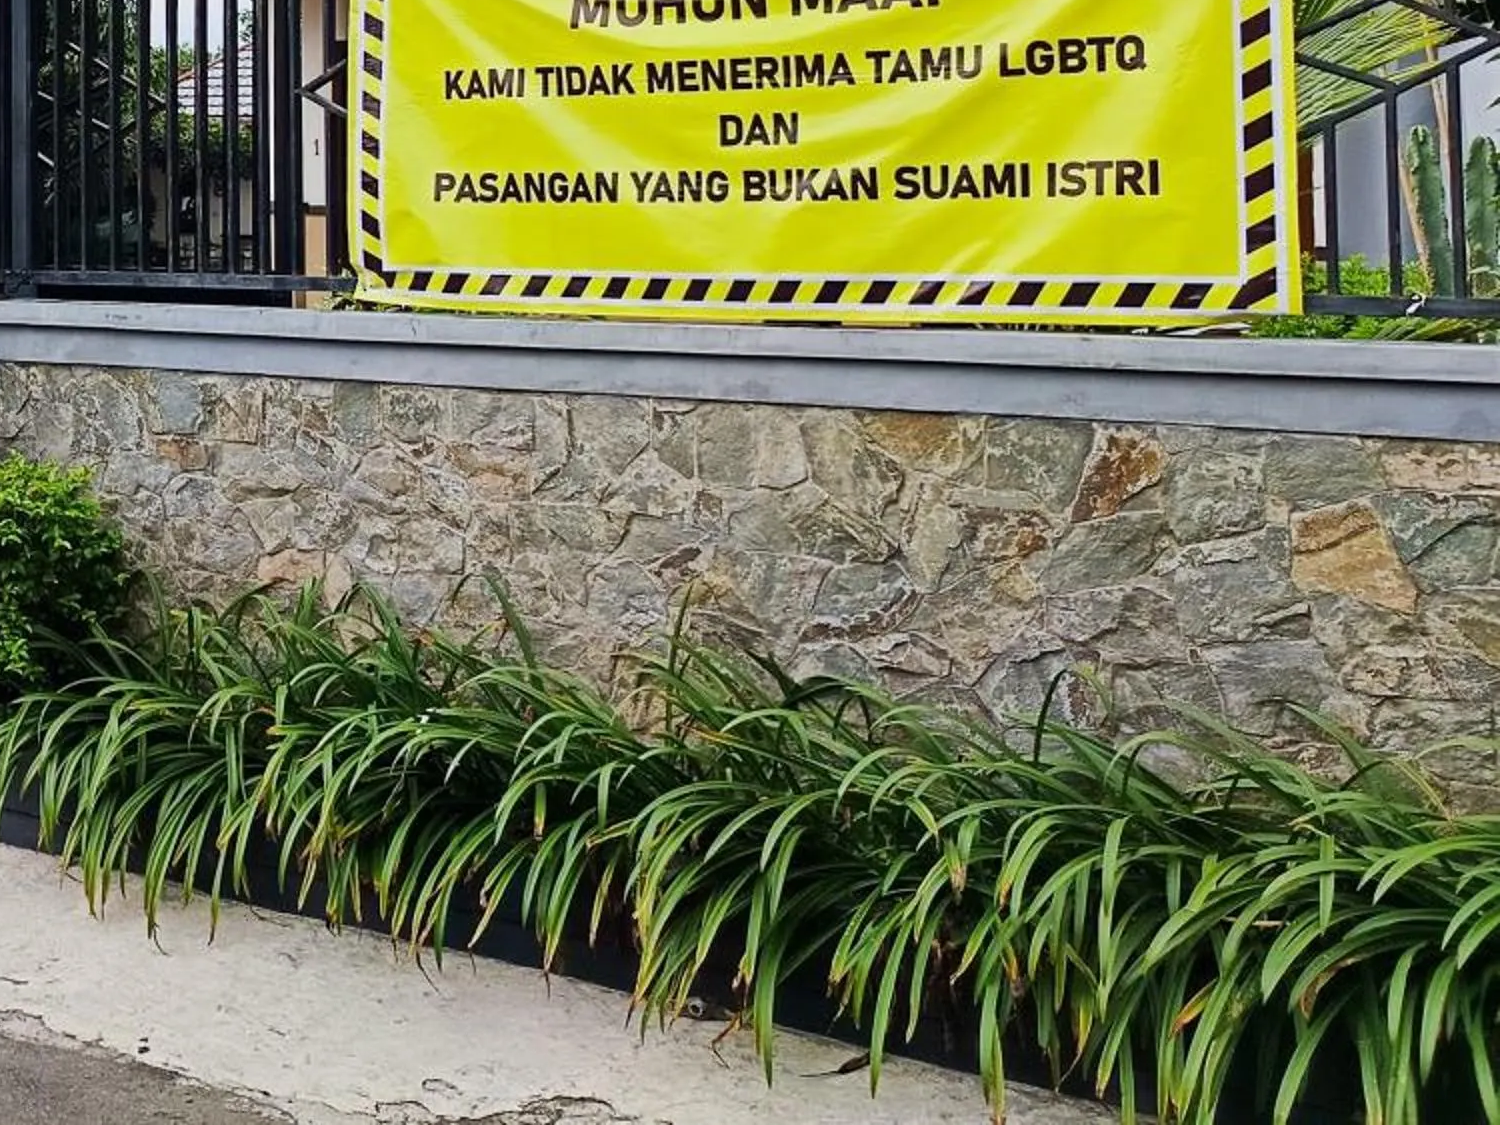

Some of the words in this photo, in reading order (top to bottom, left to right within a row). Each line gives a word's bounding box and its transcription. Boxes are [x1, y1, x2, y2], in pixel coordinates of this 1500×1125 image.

[445, 68, 525, 100] KAMI
[535, 63, 636, 97] TIDAK
[646, 53, 857, 94] MENERIMA
[865, 44, 984, 84] TAMU
[999, 35, 1148, 77] LGBTQ
[719, 112, 799, 147] DAN
[433, 172, 619, 203] PASANGAN
[629, 170, 730, 203] YANG
[742, 166, 880, 203] BUKAN
[894, 162, 1031, 200] SUAMI
[1047, 159, 1161, 198] ISTRI
